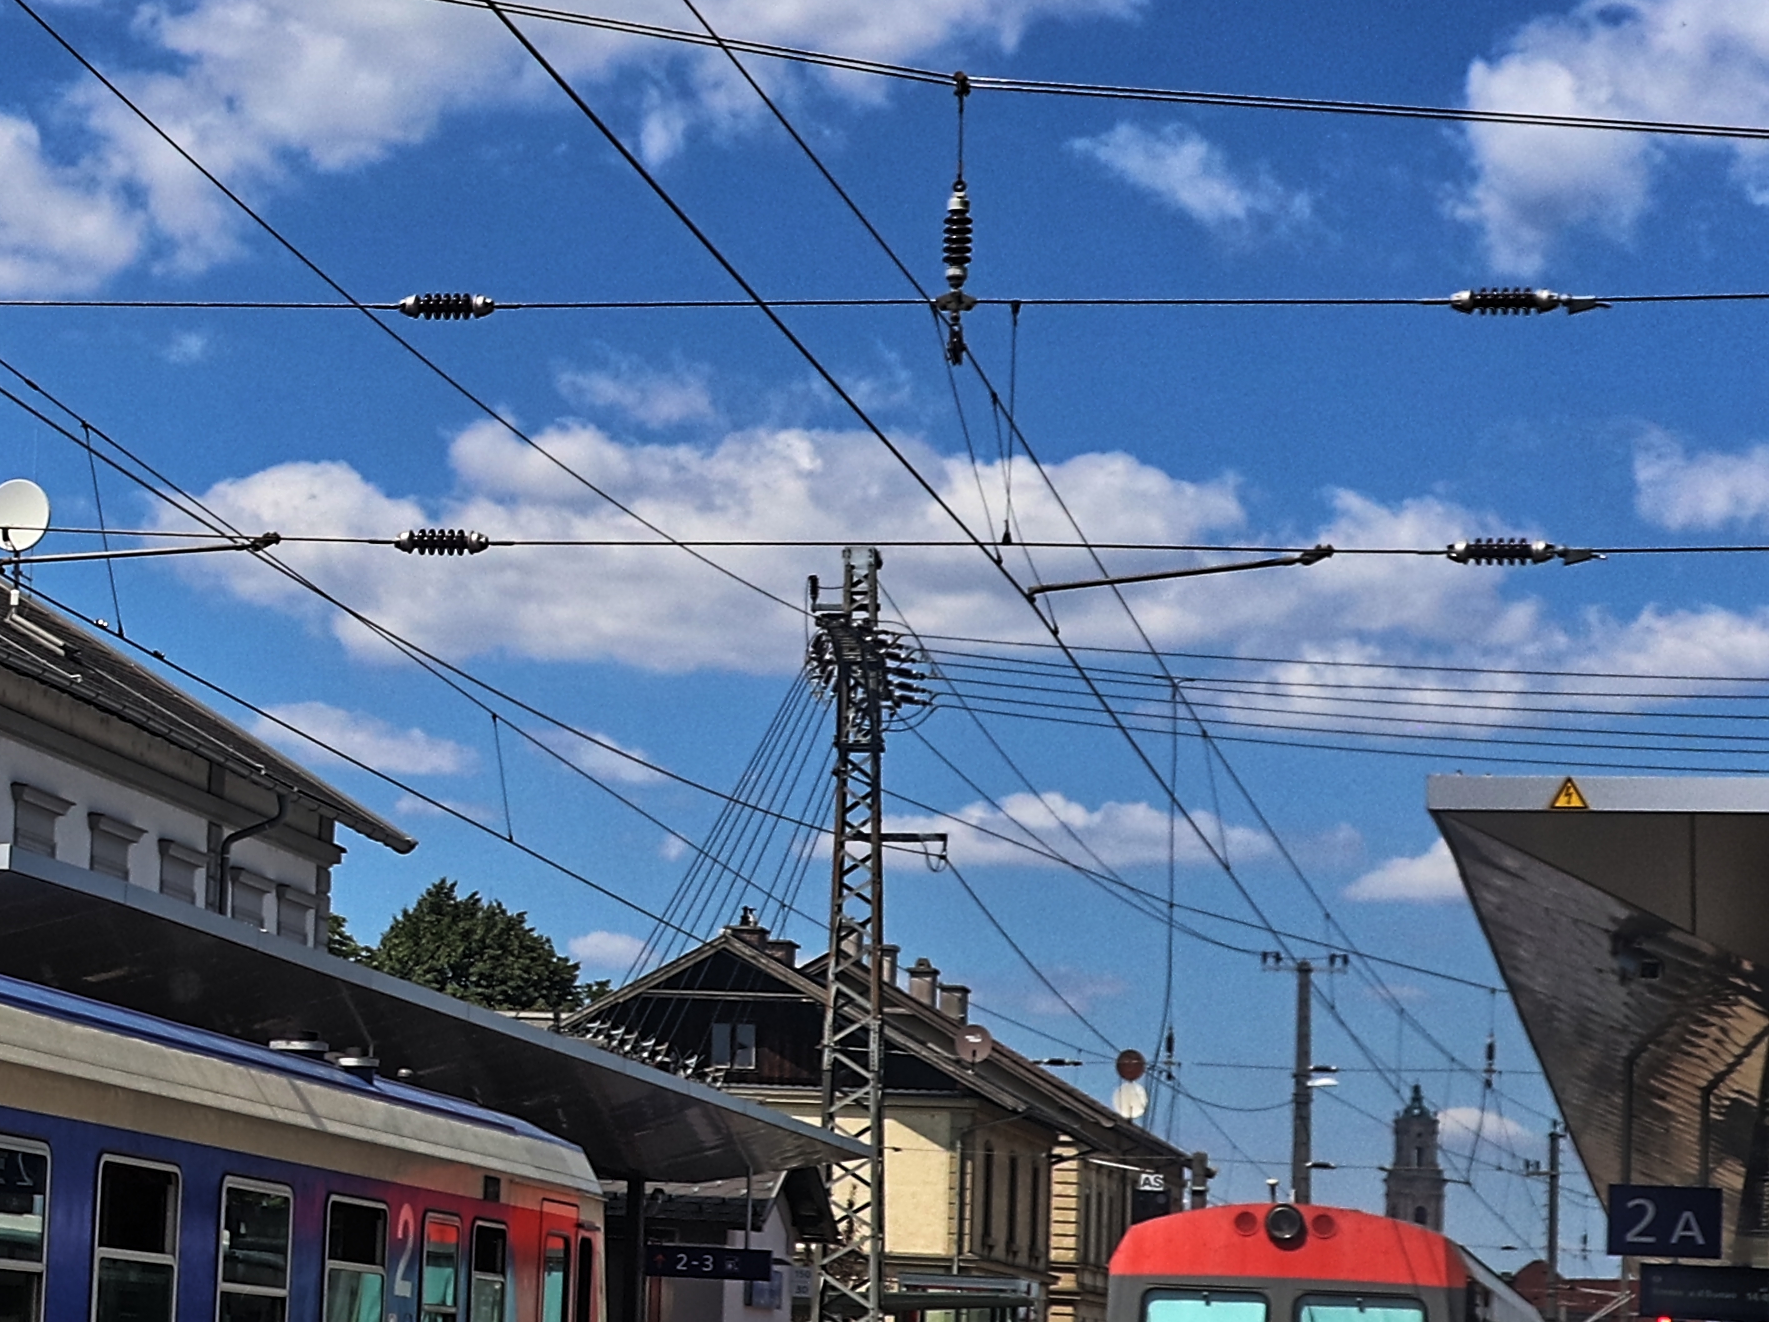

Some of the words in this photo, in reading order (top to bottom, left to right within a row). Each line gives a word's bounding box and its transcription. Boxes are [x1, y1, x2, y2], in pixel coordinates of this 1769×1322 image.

[1625, 1197, 1657, 1243] 2
[1670, 1210, 1707, 1245] A
[393, 1203, 415, 1298] 2
[675, 1253, 714, 1272] 2-3
